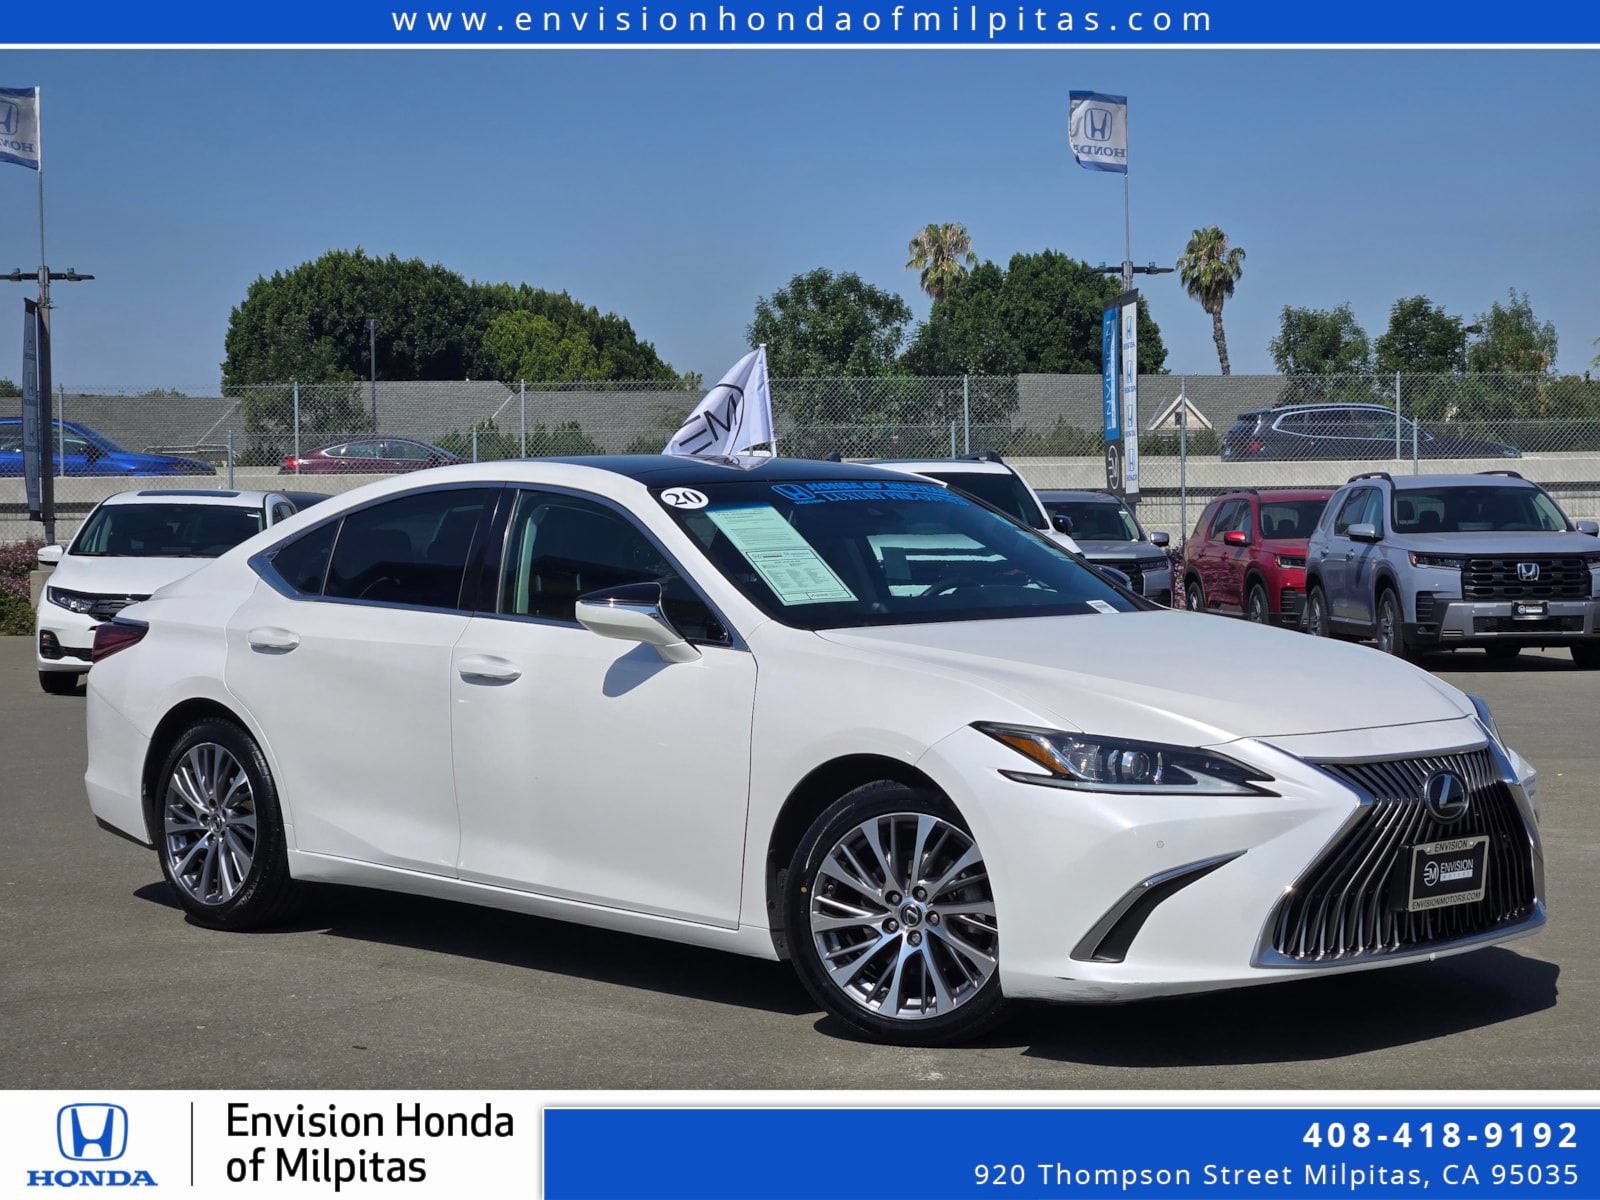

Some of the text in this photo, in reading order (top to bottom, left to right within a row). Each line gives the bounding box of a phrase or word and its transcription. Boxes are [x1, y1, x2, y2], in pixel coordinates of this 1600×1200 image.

[665, 491, 702, 505] 20
[1434, 839, 1468, 853] ENVISION
[1440, 858, 1474, 873] ENVISION
